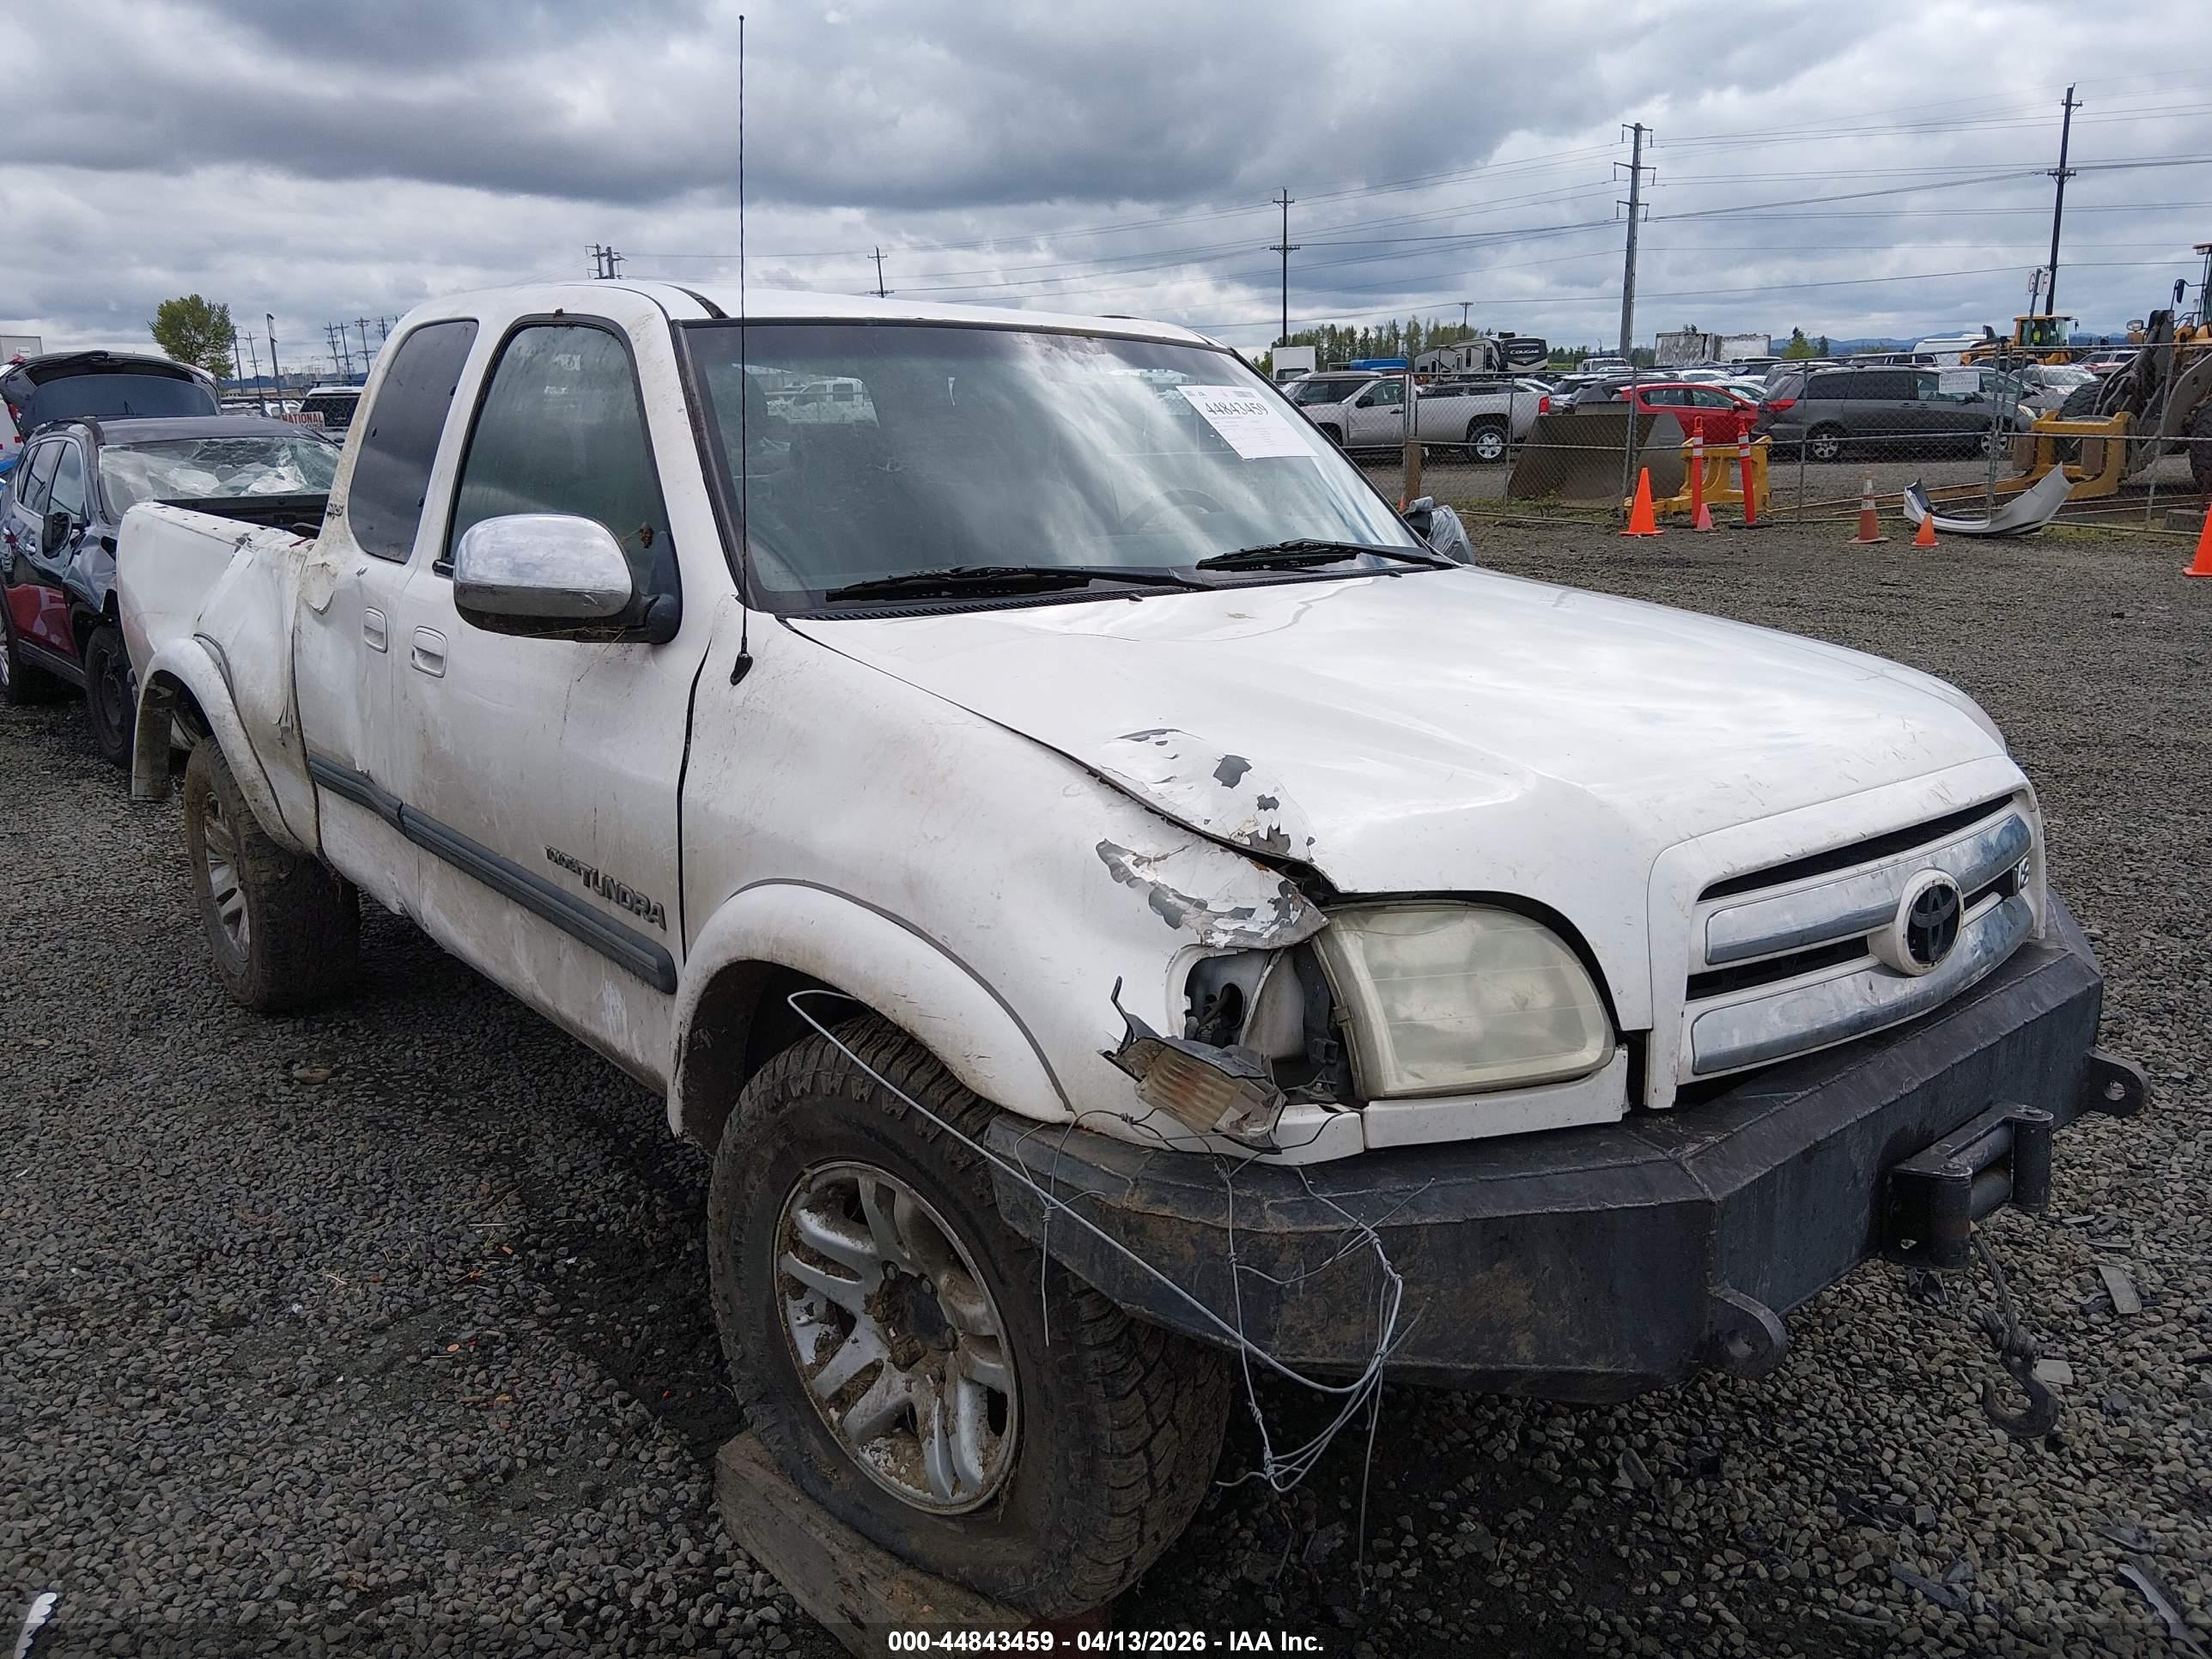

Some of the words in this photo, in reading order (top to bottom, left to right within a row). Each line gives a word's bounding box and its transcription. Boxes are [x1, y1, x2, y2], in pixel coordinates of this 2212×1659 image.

[2041, 273, 2049, 293] F
[1205, 402, 1269, 416] 44843459
[282, 413, 324, 424] NATIONAL
[579, 860, 667, 932] TUNDRA
